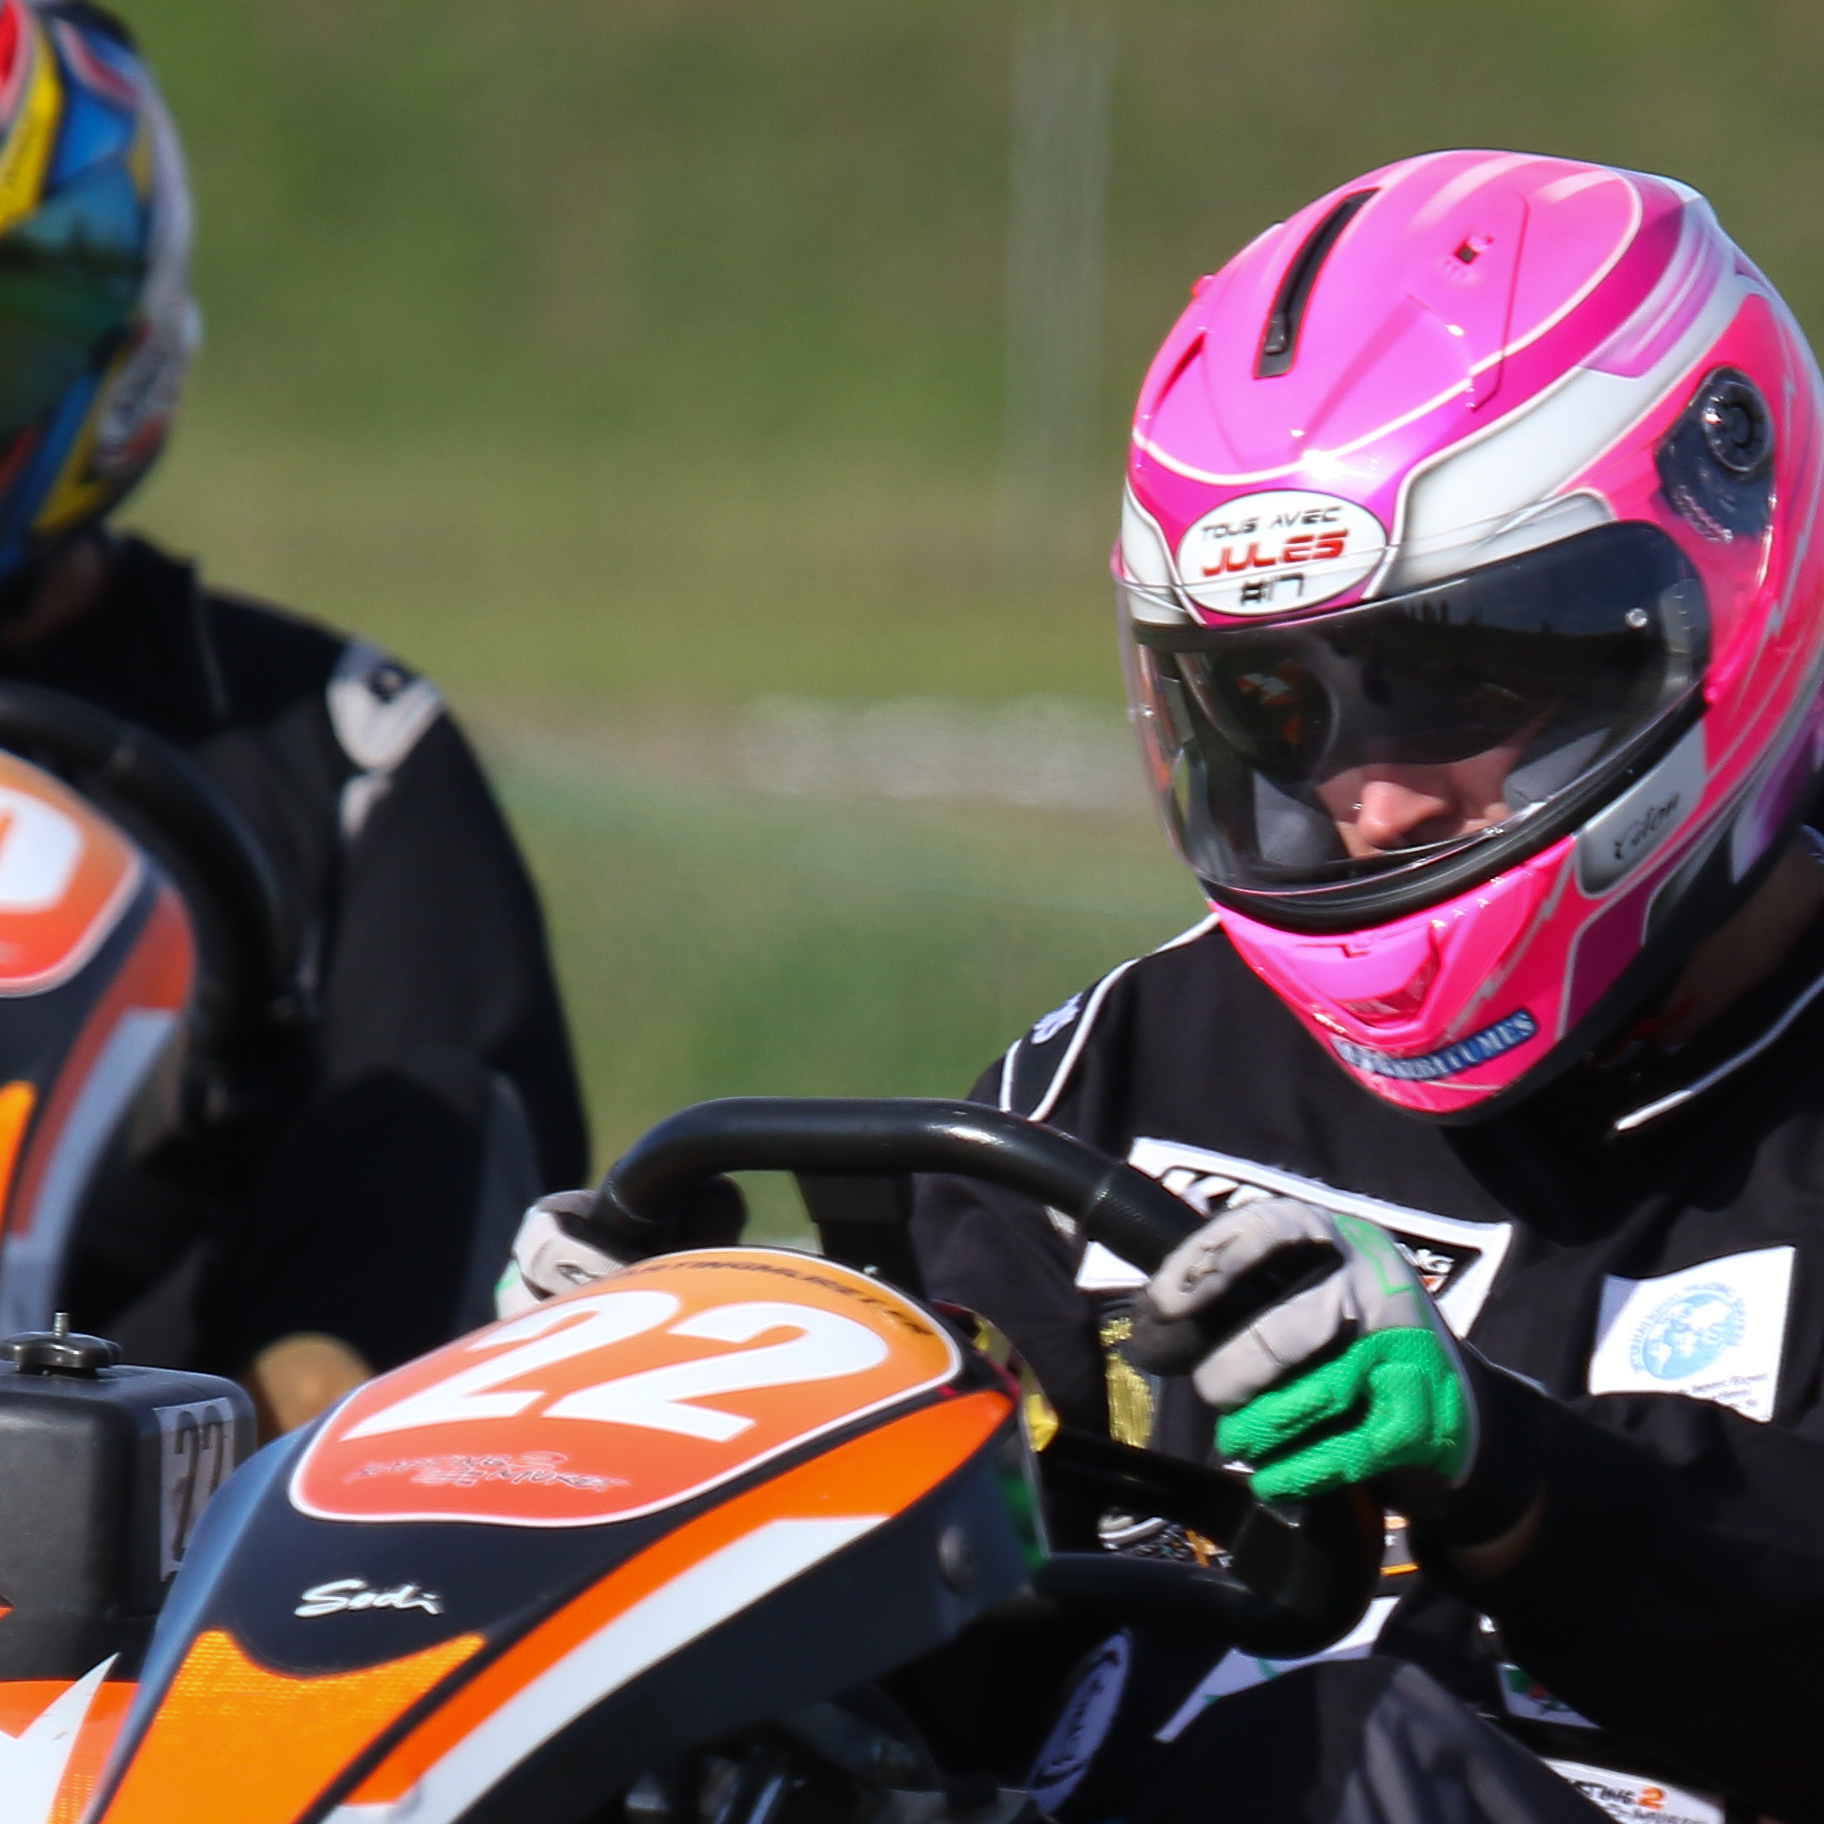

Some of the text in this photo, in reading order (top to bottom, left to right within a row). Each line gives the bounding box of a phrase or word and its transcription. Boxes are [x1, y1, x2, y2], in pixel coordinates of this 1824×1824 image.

[1201, 505, 1343, 541] TOUS AVEC
[1202, 528, 1350, 578] JULES
[338, 1290, 892, 1444] 22
[173, 1403, 225, 1562] 22
[294, 1578, 444, 1619] Sodi
[1638, 1786, 1666, 1811] 2
